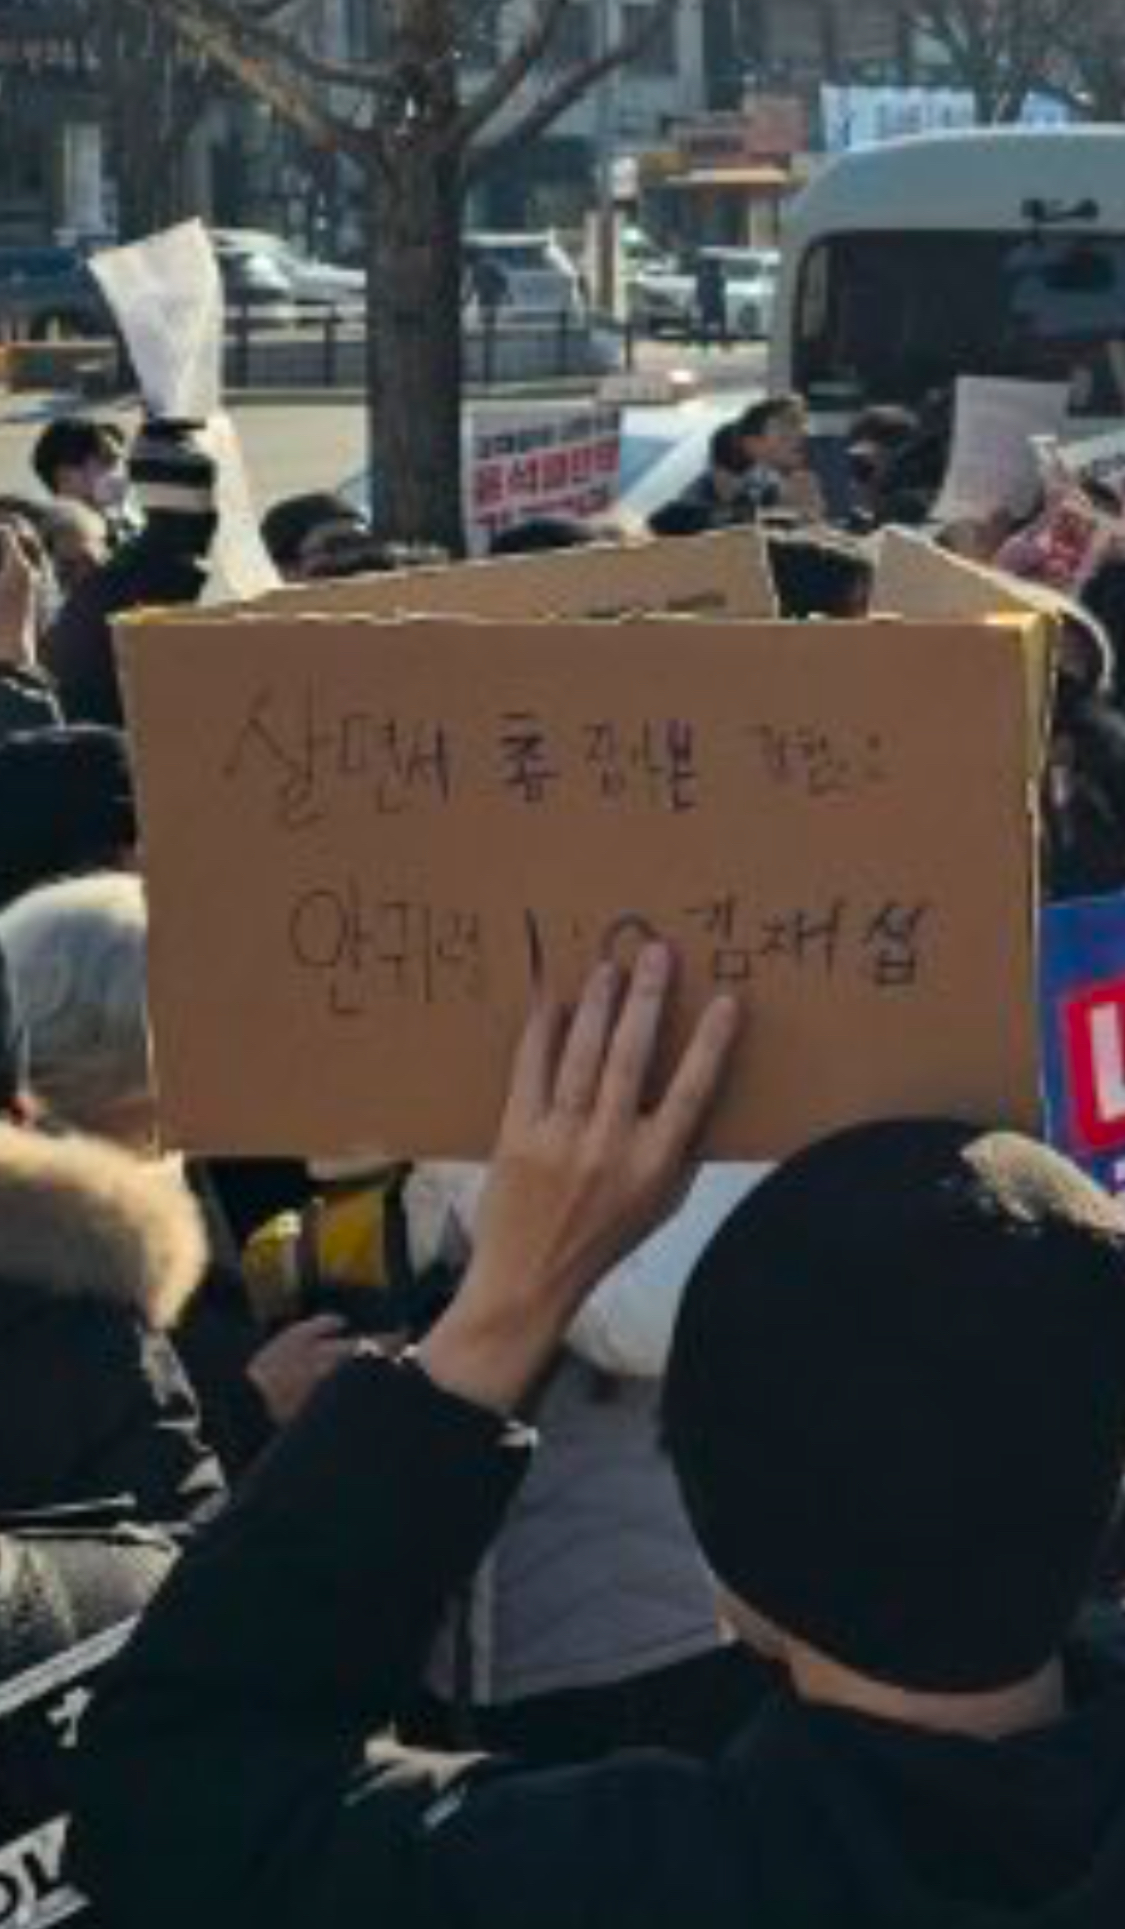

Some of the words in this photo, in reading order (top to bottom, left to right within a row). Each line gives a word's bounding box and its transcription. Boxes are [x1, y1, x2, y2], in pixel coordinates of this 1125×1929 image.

[222, 678, 450, 831] 살면서
[500, 710, 561, 802] 총
[685, 896, 932, 986] 김재섭
